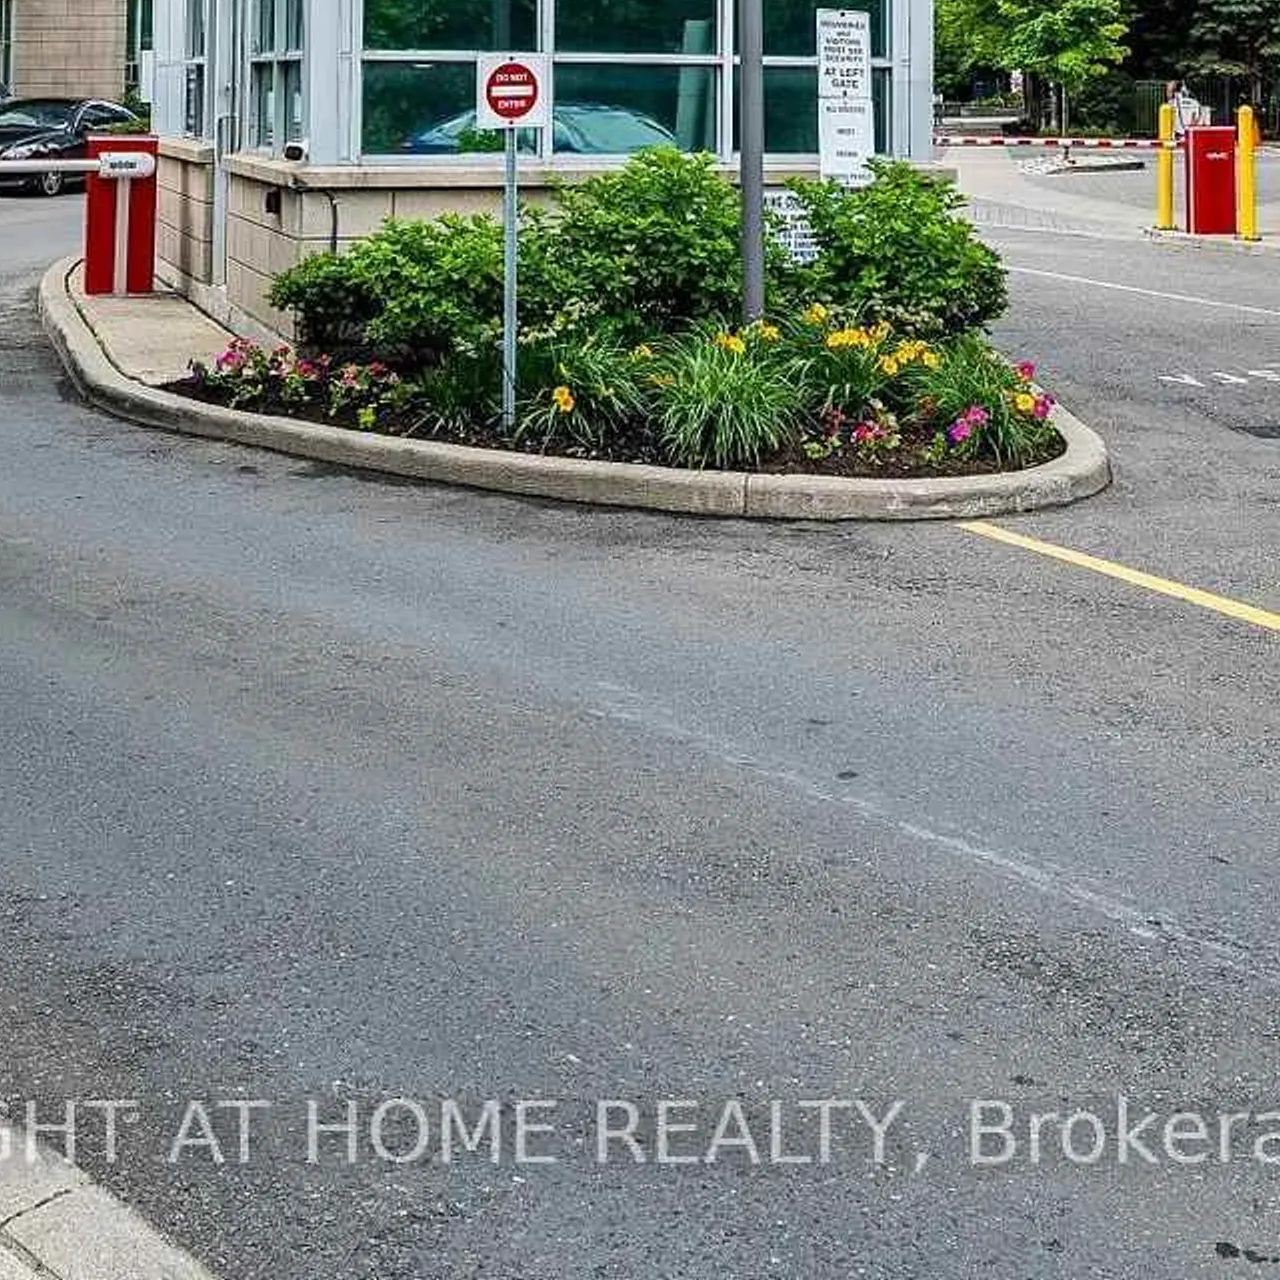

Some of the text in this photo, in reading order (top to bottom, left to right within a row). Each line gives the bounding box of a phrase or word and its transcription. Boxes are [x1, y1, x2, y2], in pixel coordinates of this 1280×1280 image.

[824, 67, 864, 78] AT LEFT
[496, 74, 509, 82] DO
[831, 78, 860, 90] GATE
[498, 100, 525, 109] ENTER
